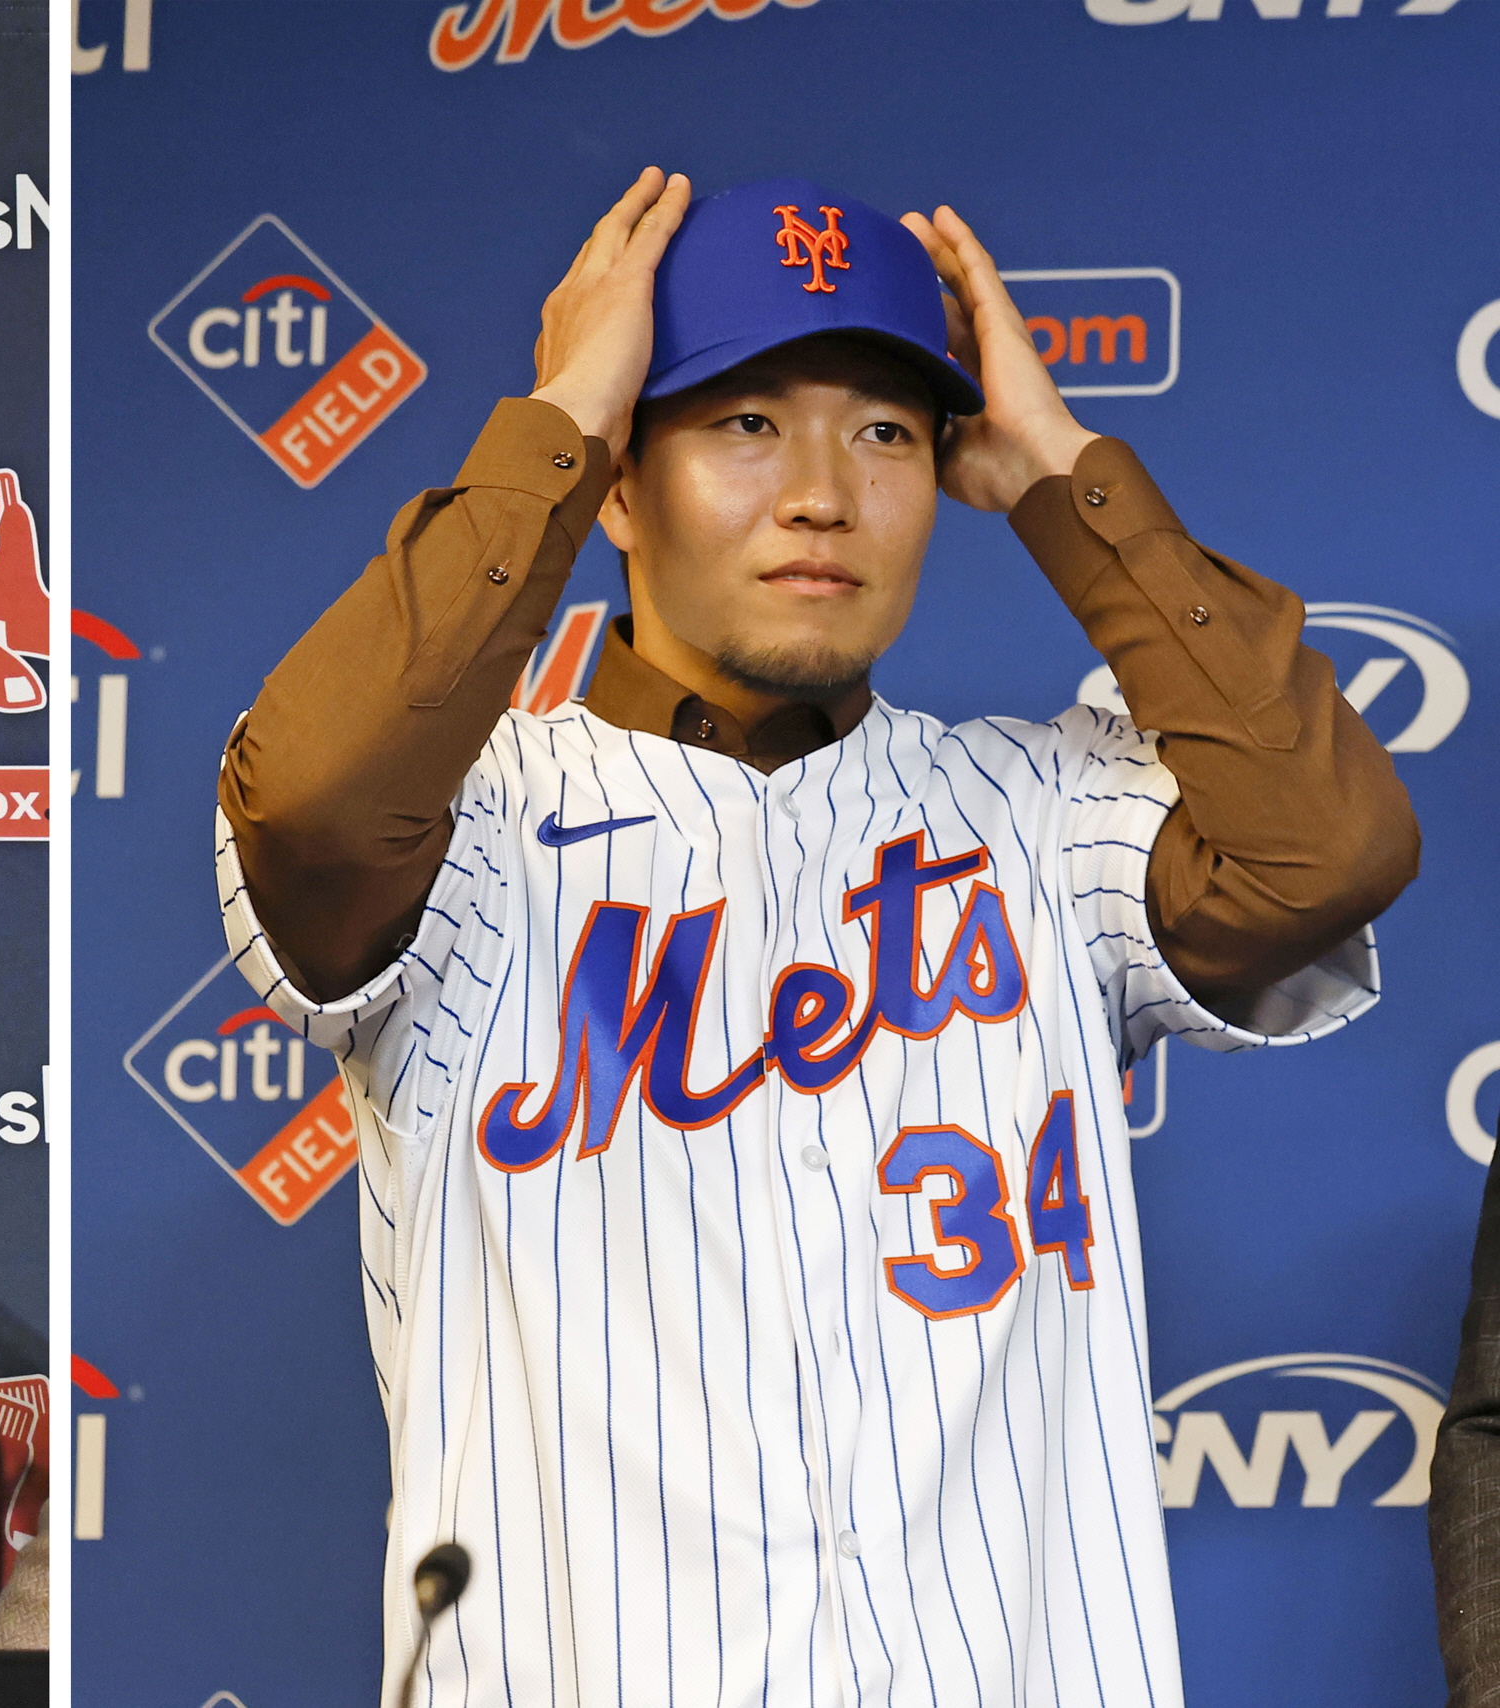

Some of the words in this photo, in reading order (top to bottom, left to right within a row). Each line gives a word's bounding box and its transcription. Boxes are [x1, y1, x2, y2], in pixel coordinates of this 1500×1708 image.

[279, 347, 402, 469] FIELD
[477, 829, 1028, 1174] Mets
[258, 1089, 357, 1206] FIEL
[877, 1089, 1096, 1322] 34
